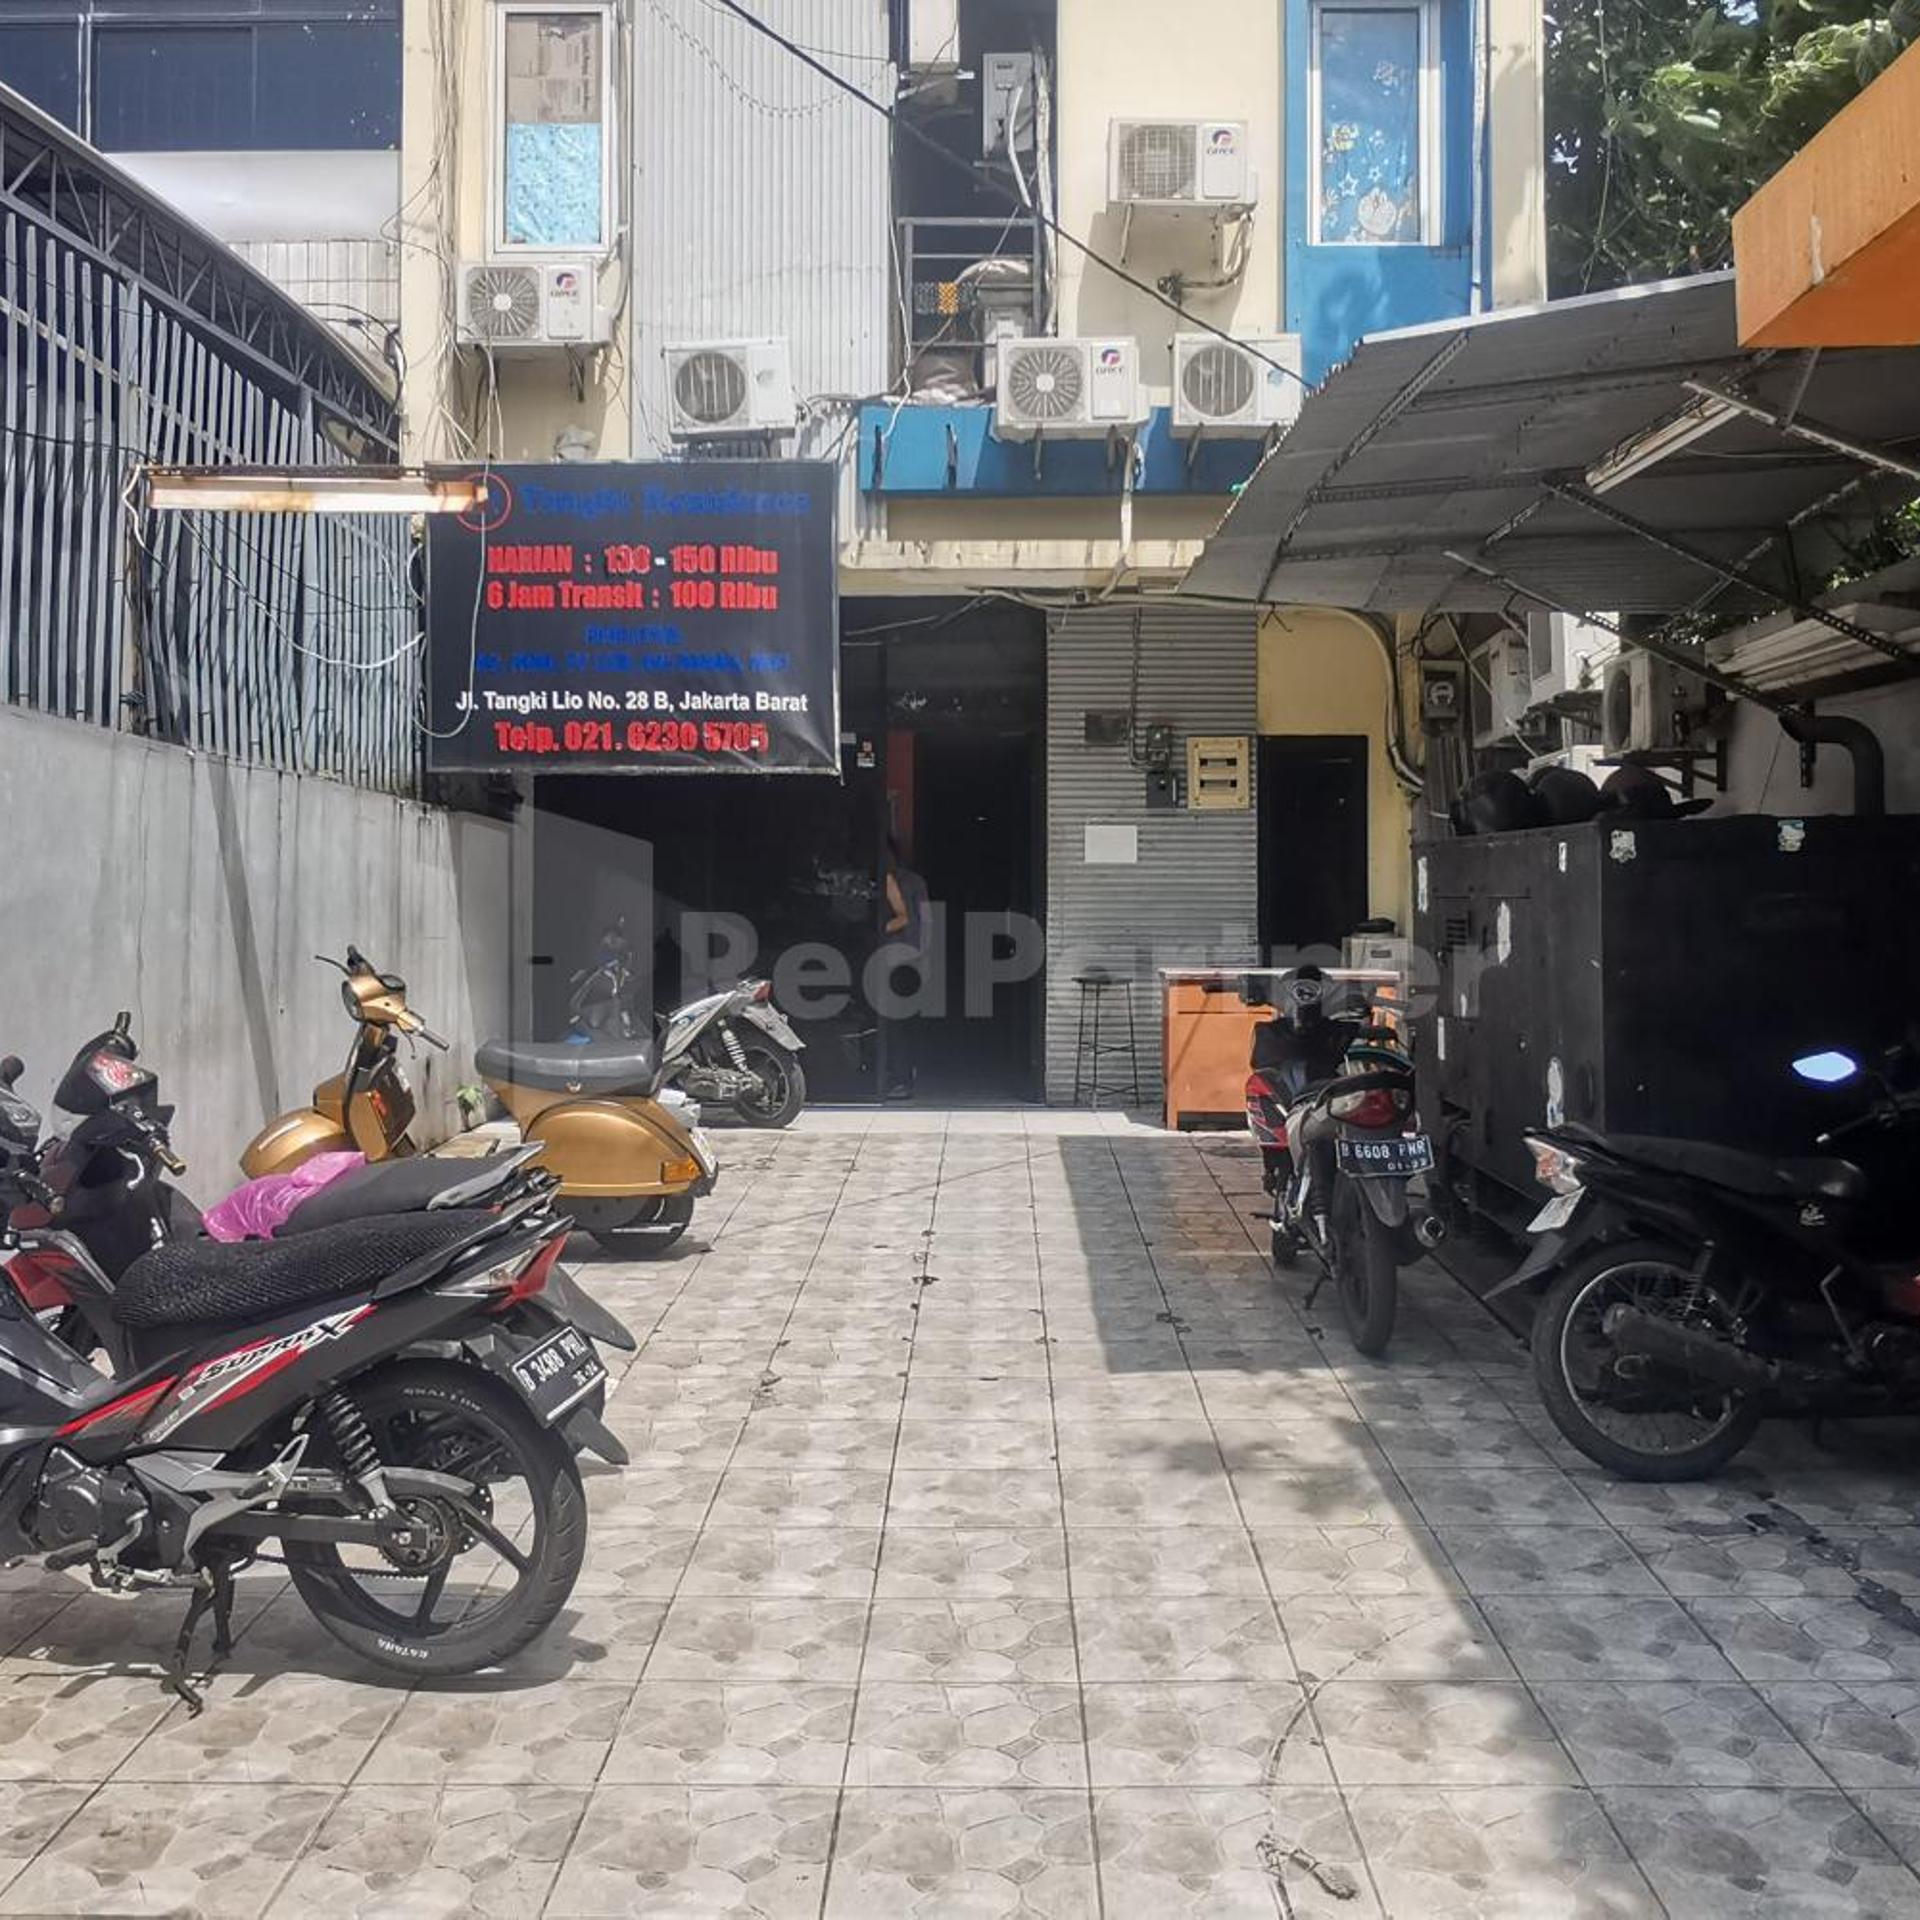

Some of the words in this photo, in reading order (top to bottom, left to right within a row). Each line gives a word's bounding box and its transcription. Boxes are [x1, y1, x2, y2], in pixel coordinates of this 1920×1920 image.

[670, 545, 716, 573] 150
[487, 581, 504, 609] 6
[507, 581, 555, 609] Jam
[558, 581, 644, 609] Transit
[669, 581, 716, 609] 100
[455, 691, 479, 710] Jl.
[483, 691, 547, 714] Tangki
[552, 691, 583, 710] Lio
[588, 691, 621, 710] No.
[625, 691, 649, 710] 28
[653, 691, 674, 712] B,
[679, 692, 750, 711] Jakarta
[755, 692, 808, 712] Barat
[494, 721, 559, 753] Telp.
[627, 721, 698, 751] 6230
[519, 1368, 537, 1391] B
